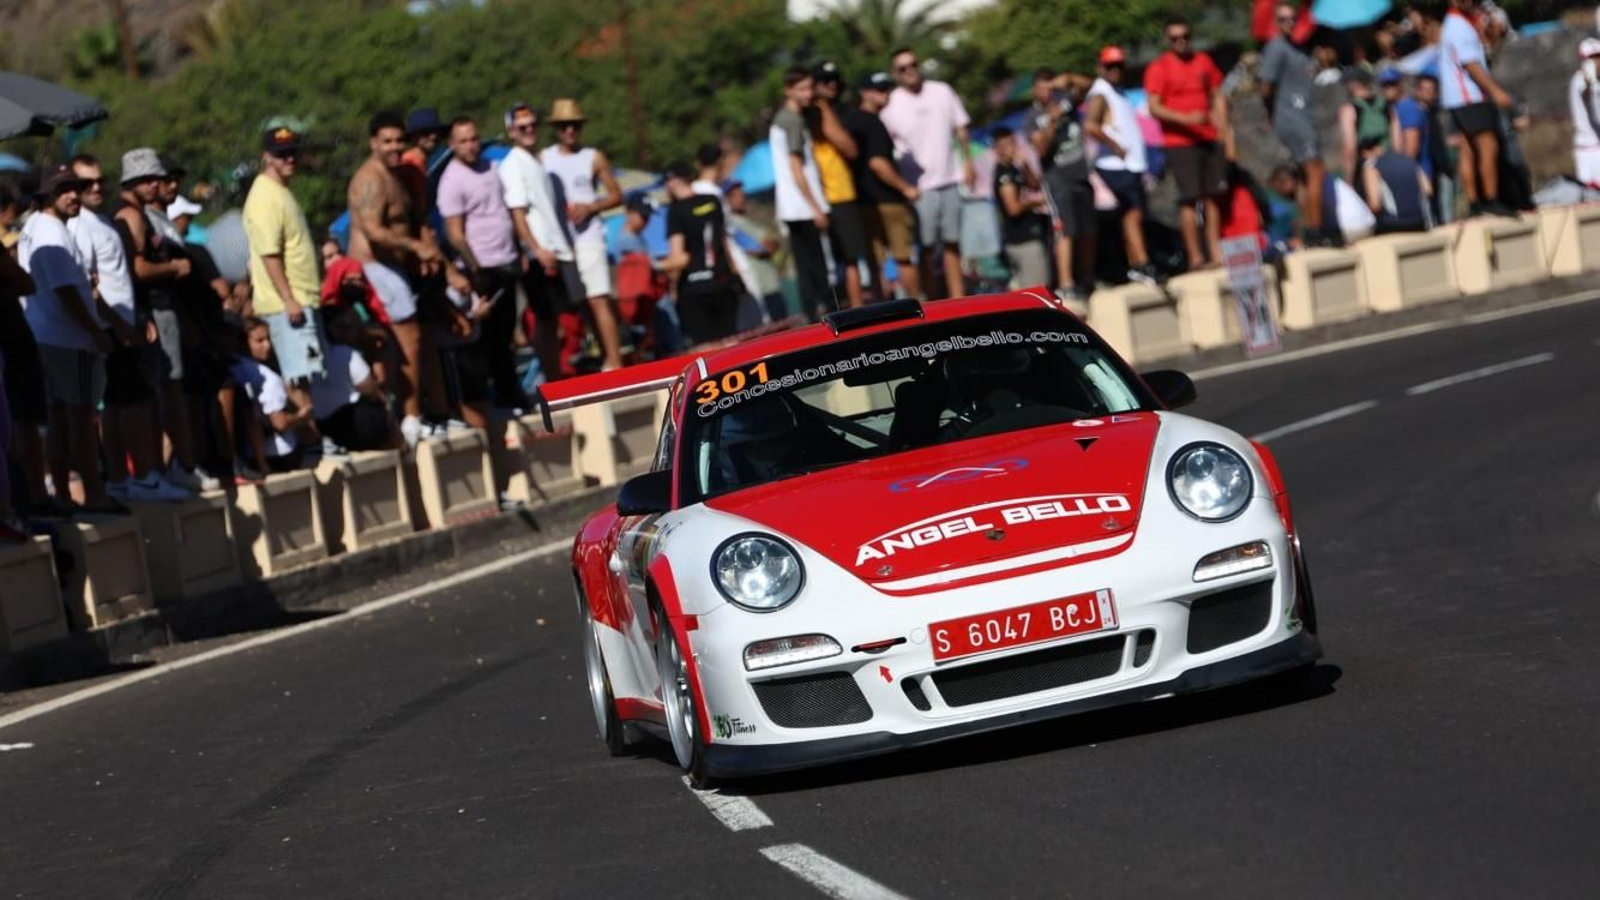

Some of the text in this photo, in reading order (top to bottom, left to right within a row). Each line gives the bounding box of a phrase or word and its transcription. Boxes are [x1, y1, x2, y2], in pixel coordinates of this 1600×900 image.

[695, 362, 769, 404] 301
[855, 495, 1132, 567] ANGEL BELLO
[935, 629, 951, 653] S
[968, 612, 1031, 647] 6047
[1049, 599, 1097, 632] BCJ
